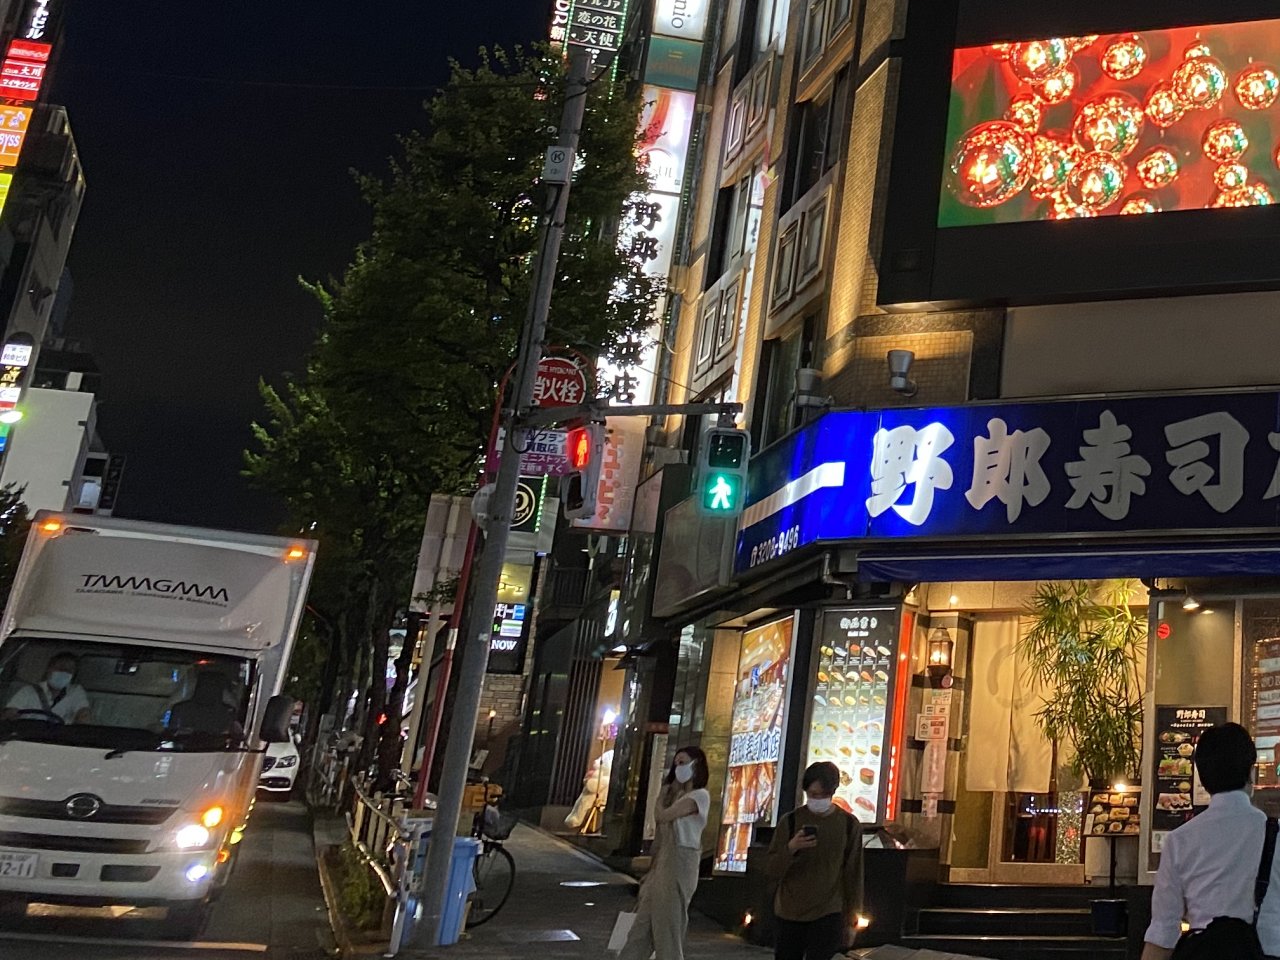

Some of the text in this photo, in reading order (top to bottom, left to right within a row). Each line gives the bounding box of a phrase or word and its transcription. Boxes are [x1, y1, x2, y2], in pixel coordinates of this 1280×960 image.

[577, 10, 617, 29] 恋の花
[584, 30, 615, 47] 天使
[21, 66, 42, 77] 大川
[490, 640, 518, 651] NOW
[1176, 709, 1206, 719] 野郎寿司
